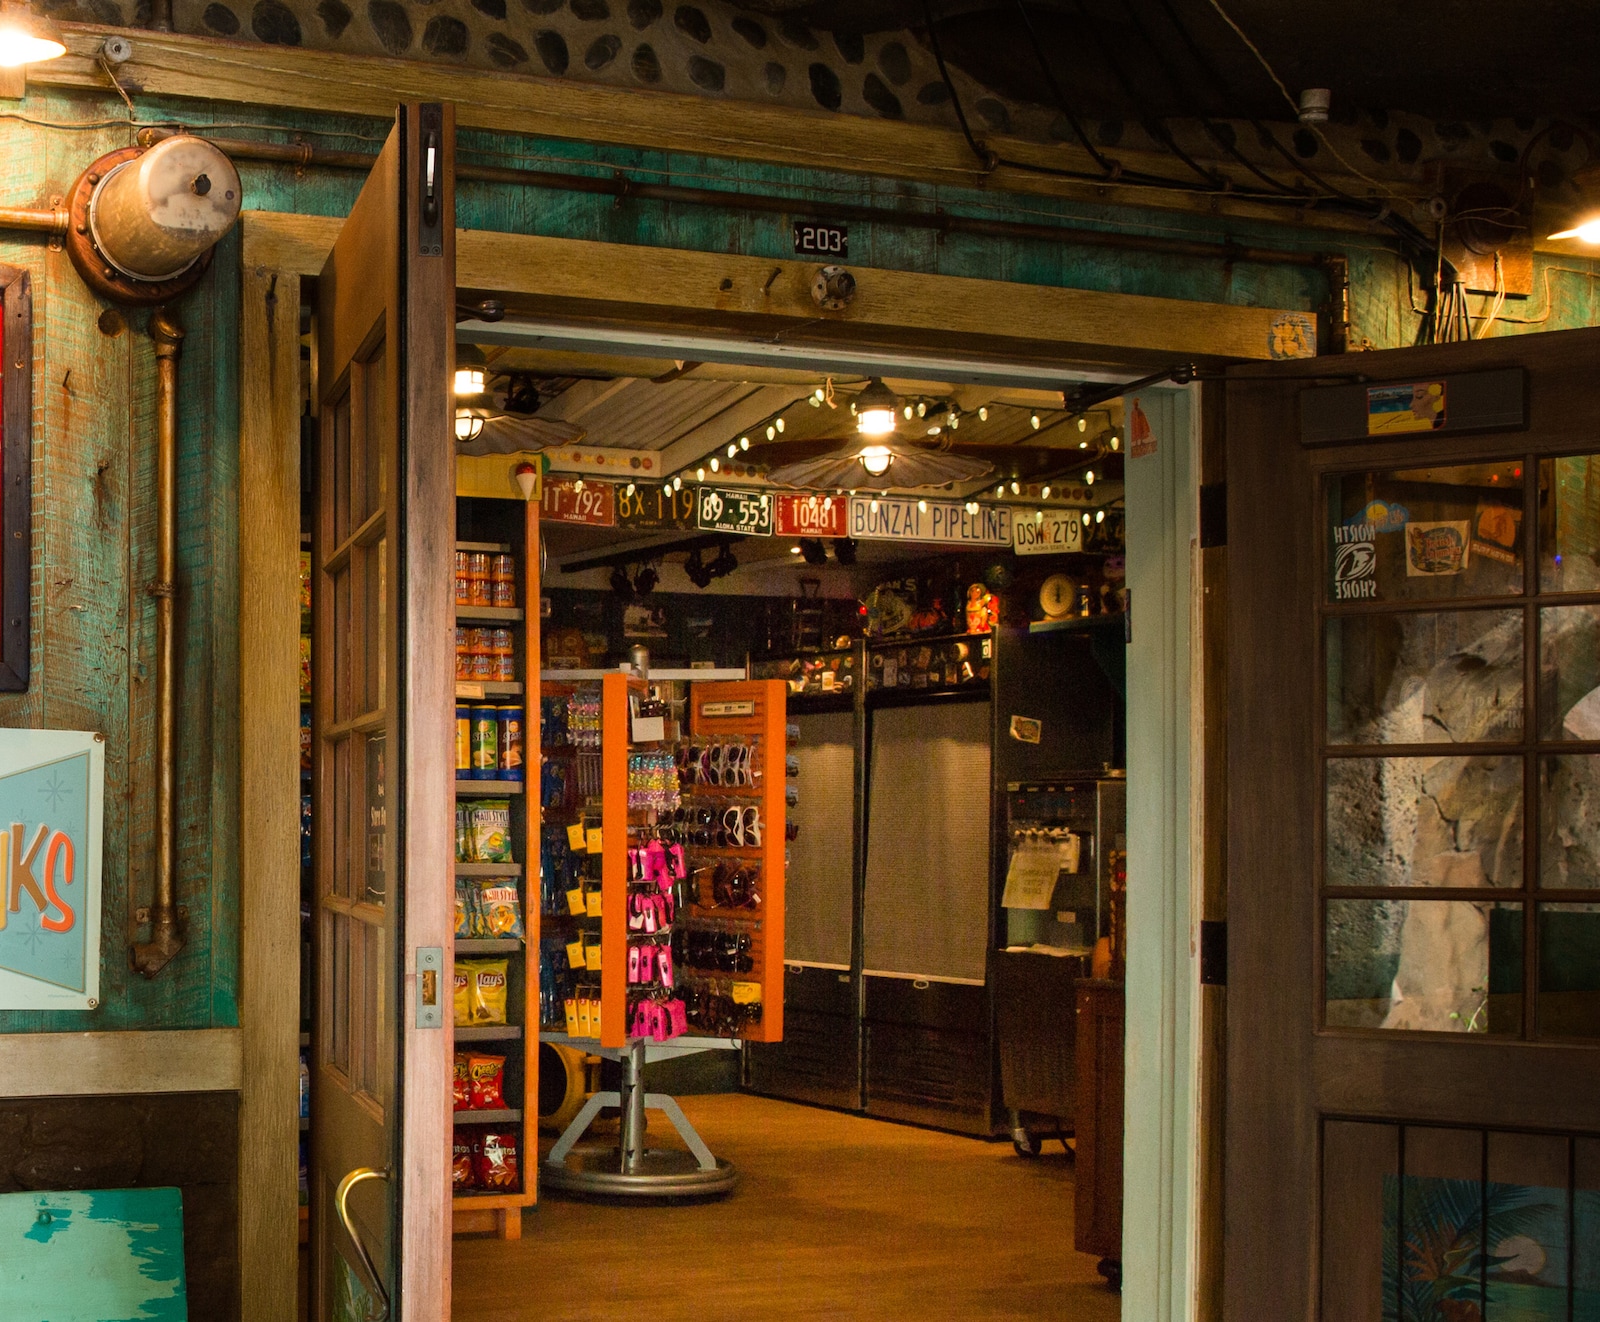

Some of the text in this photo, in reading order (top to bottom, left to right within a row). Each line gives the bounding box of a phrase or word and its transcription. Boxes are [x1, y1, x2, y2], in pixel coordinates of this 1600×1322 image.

[802, 227, 841, 252] 203
[725, 492, 748, 501] HAWAII
[563, 512, 587, 521] HAWAII
[715, 522, 756, 533] ALOHA STATE
[792, 502, 837, 528] 10481
[933, 504, 1007, 541] PIPELINE
[1017, 519, 1078, 545] DSW 279
